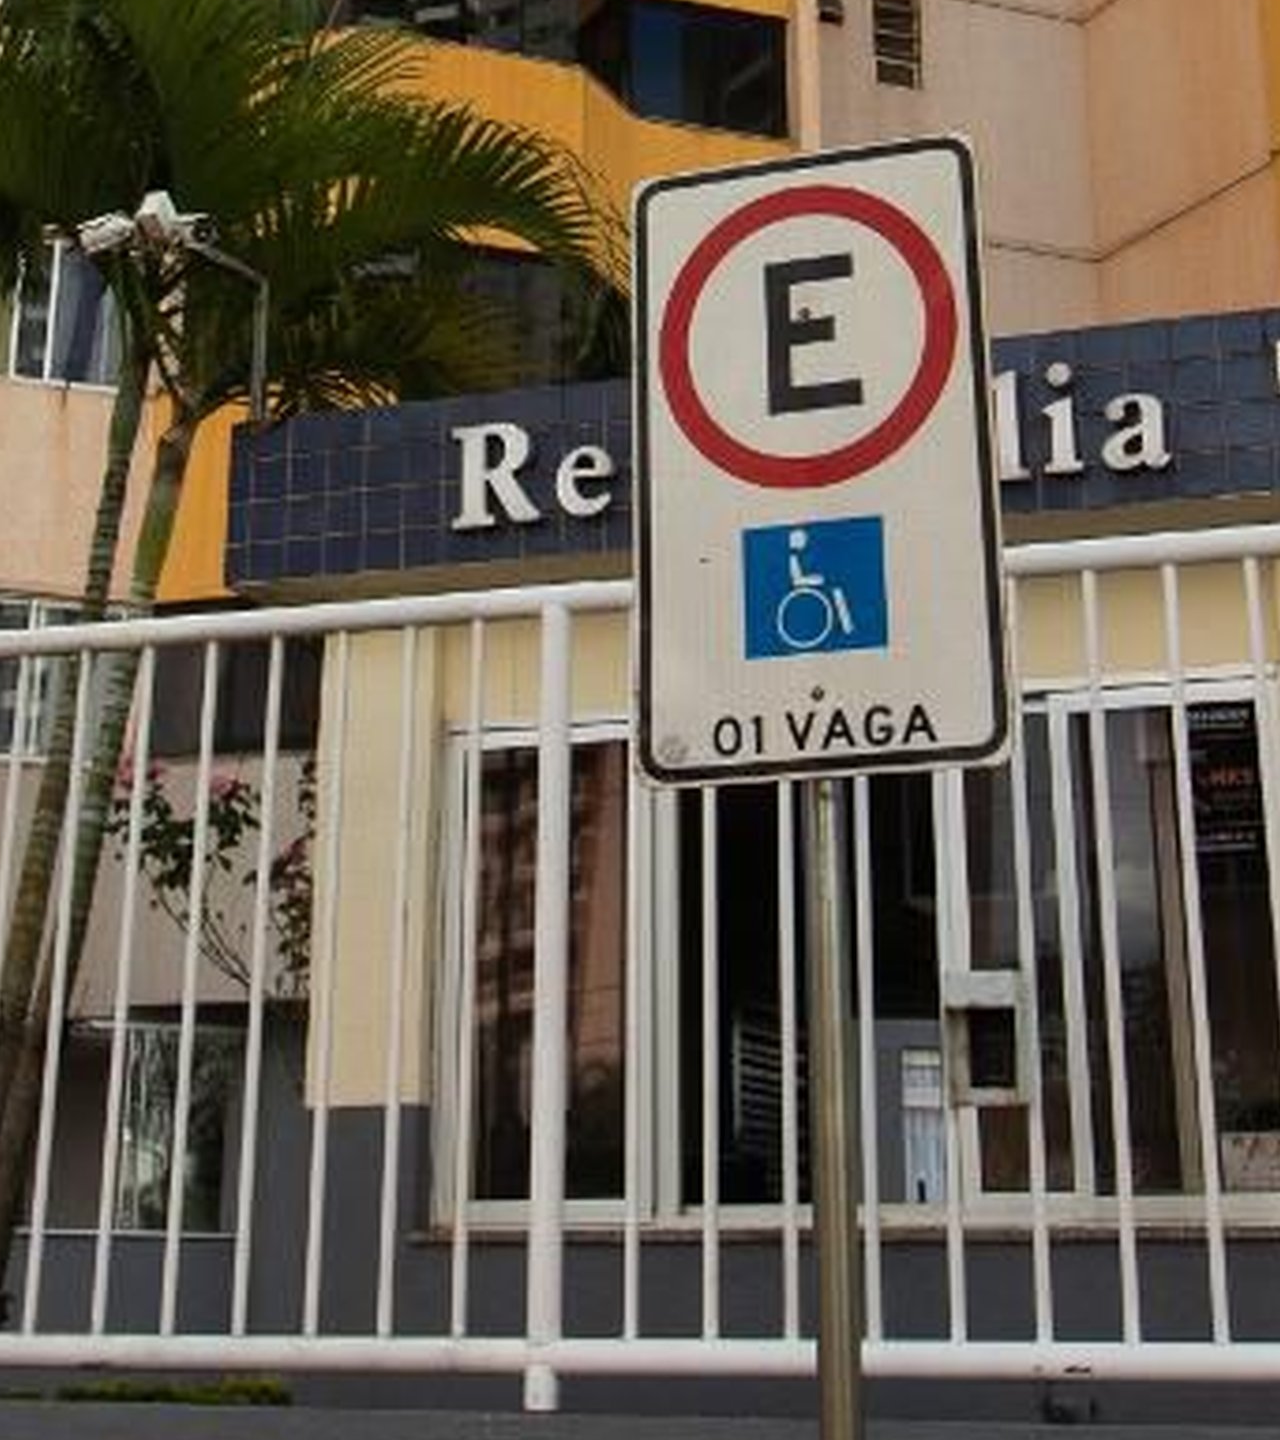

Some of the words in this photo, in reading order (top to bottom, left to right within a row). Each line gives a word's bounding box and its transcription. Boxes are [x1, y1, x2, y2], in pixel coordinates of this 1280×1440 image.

[764, 253, 865, 416] E
[450, 421, 615, 531] Re
[992, 362, 1172, 482] lia
[713, 715, 764, 757] 01
[785, 704, 938, 751] VAGA
